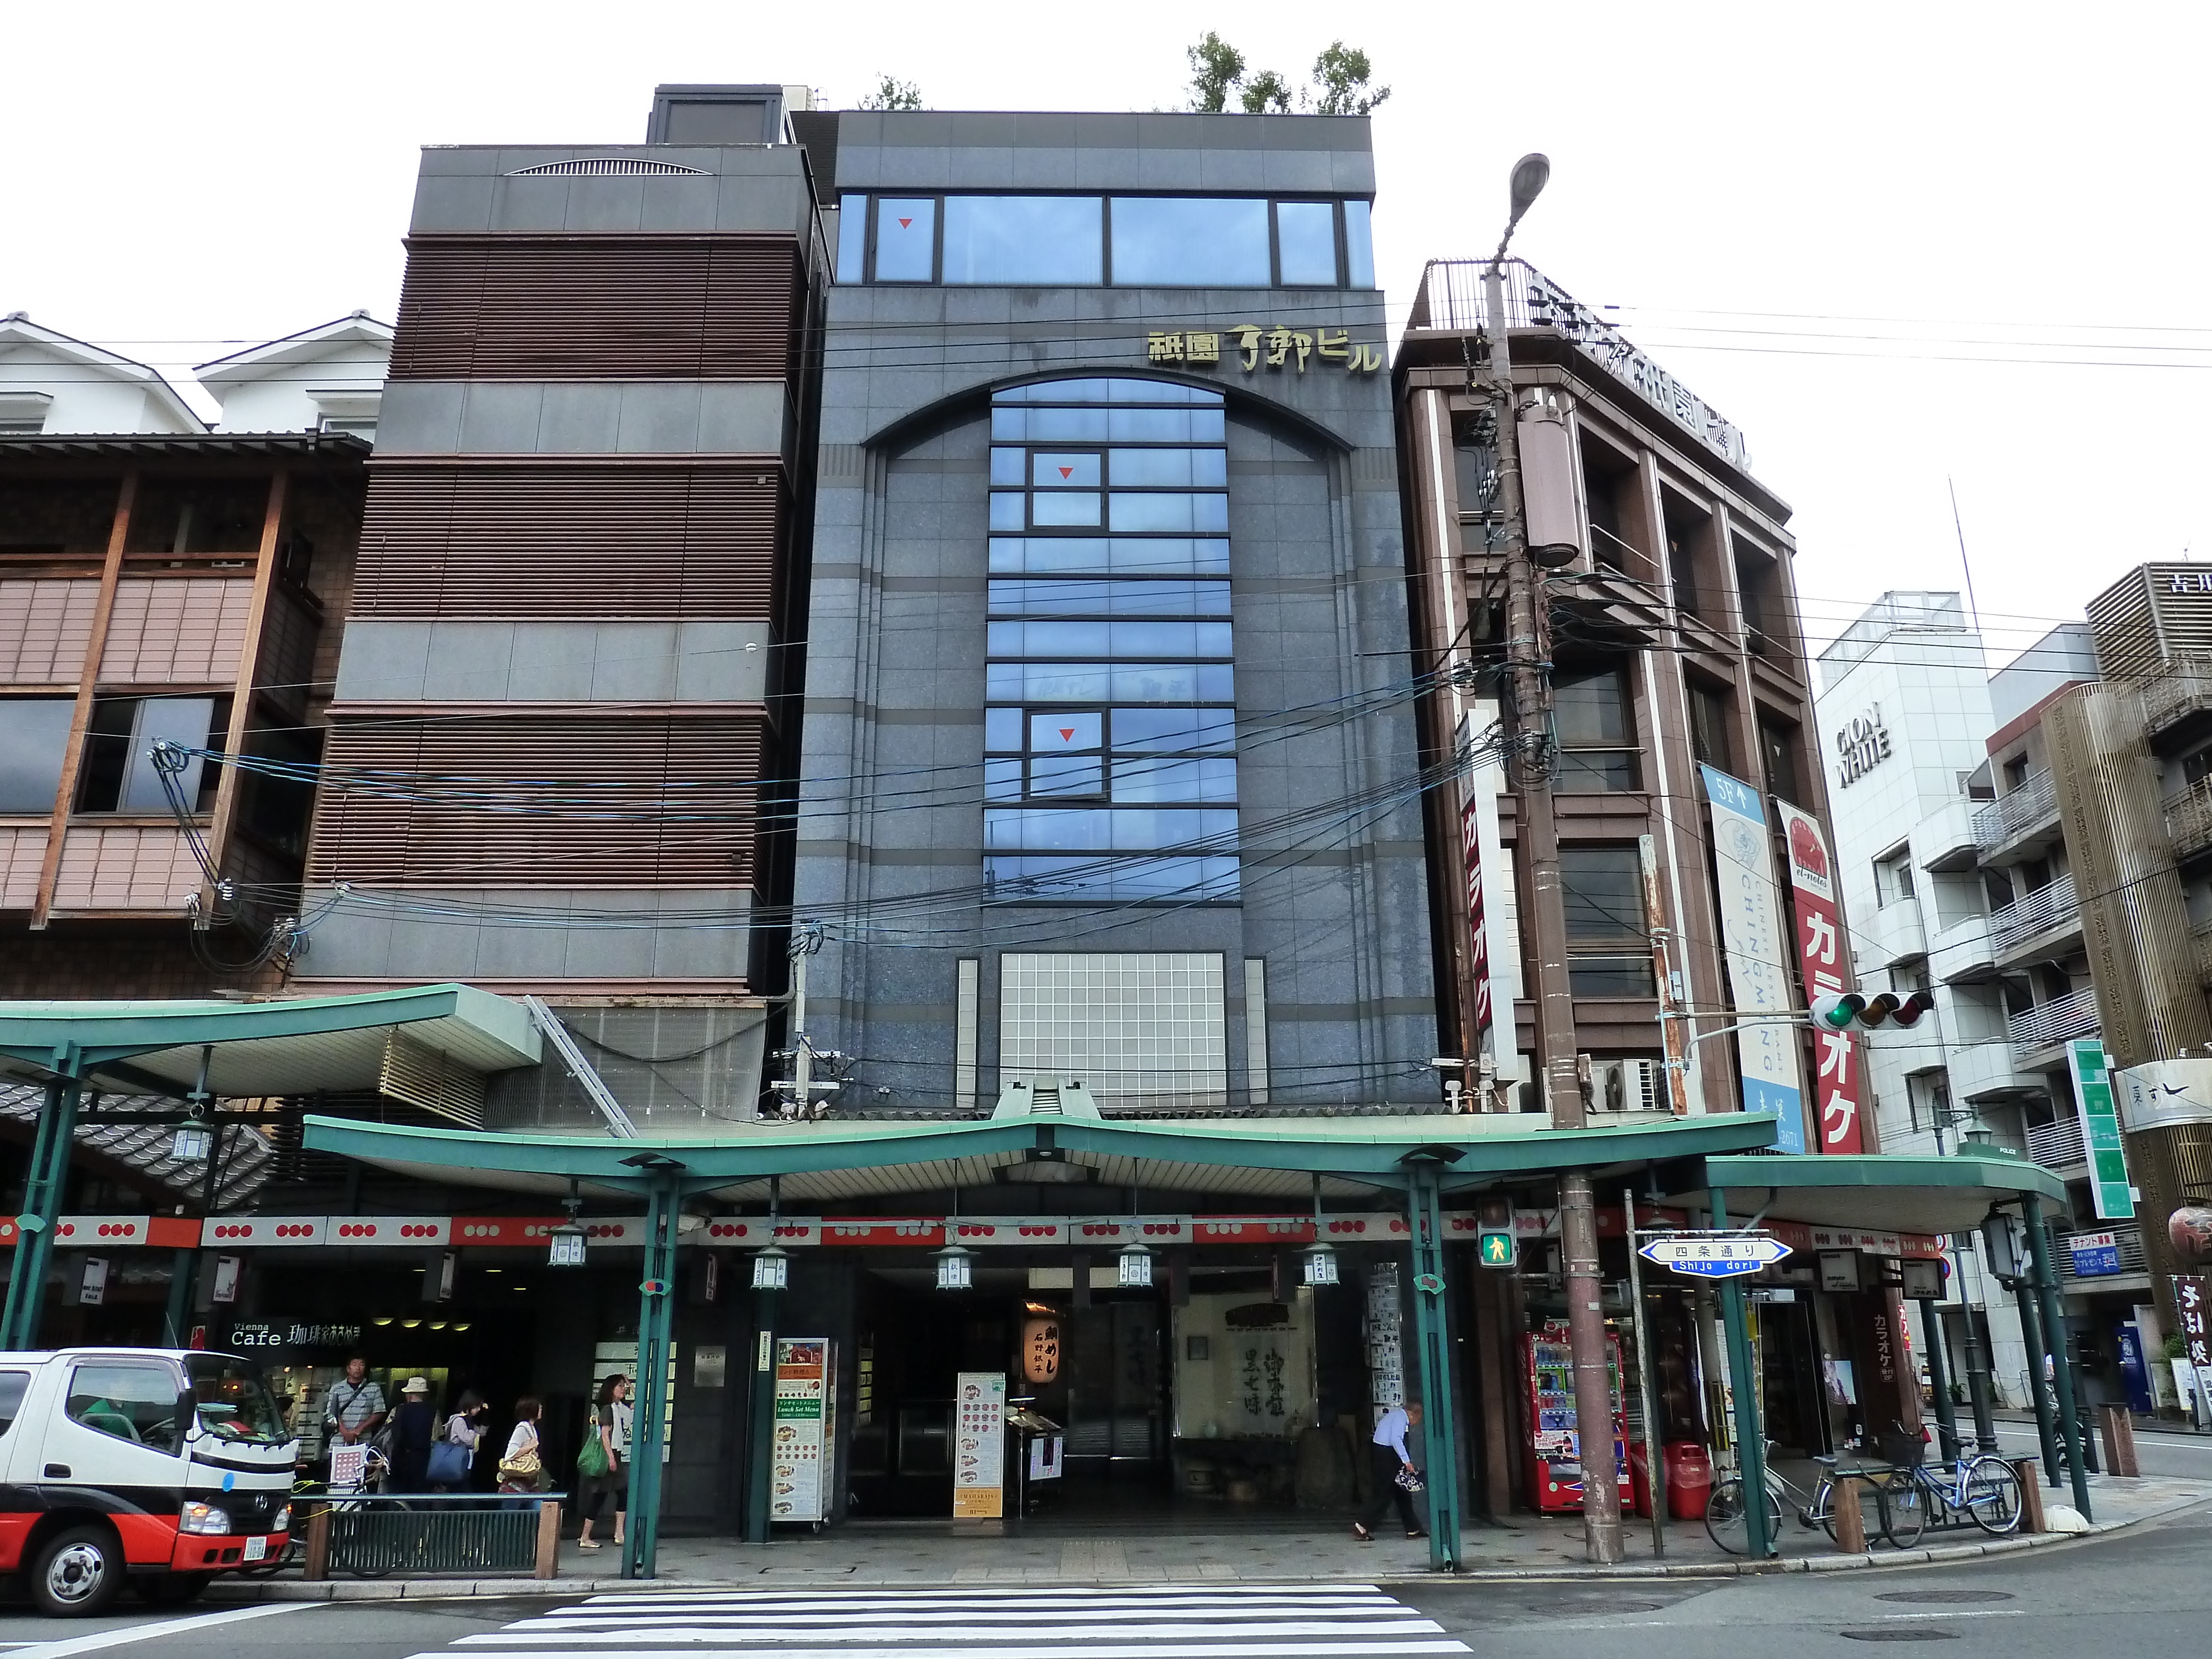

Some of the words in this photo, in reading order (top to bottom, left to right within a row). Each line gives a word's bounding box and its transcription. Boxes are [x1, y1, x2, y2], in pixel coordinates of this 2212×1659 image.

[1835, 701, 1881, 756] GION
[1834, 727, 1891, 790] WHITE
[1716, 777, 1734, 804] 5F
[1465, 809, 1489, 1020] カラオケ
[1755, 880, 1769, 954] CHINESE
[1999, 1147, 2016, 1155] POLICE
[1676, 1245, 1754, 1258] 四条通り
[2073, 1235, 2111, 1248] テナント募集
[1679, 1261, 1712, 1271] Shijo
[1726, 1261, 1753, 1270] dori
[232, 1331, 281, 1345] Cafe
[234, 1322, 269, 1331] Vienna
[1034, 1333, 1044, 1373] 石野銀平
[1874, 1314, 1891, 1367] カラオケ
